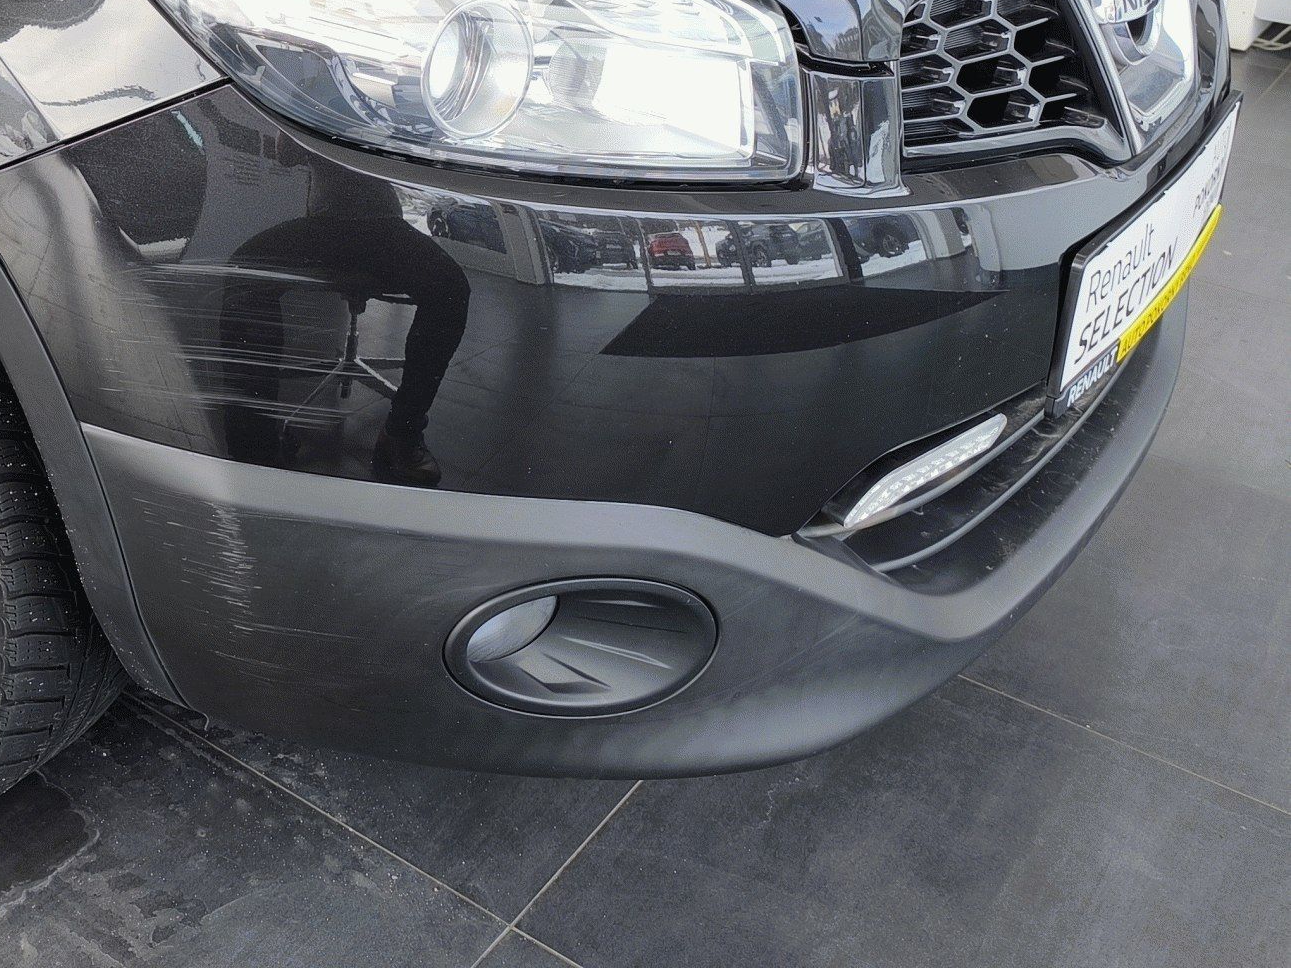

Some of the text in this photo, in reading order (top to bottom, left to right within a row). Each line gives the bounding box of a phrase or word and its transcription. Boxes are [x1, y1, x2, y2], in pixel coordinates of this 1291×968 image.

[1073, 236, 1179, 365] SELECTION
[1085, 223, 1155, 313] Renault
[1066, 345, 1119, 408] RENAULT
